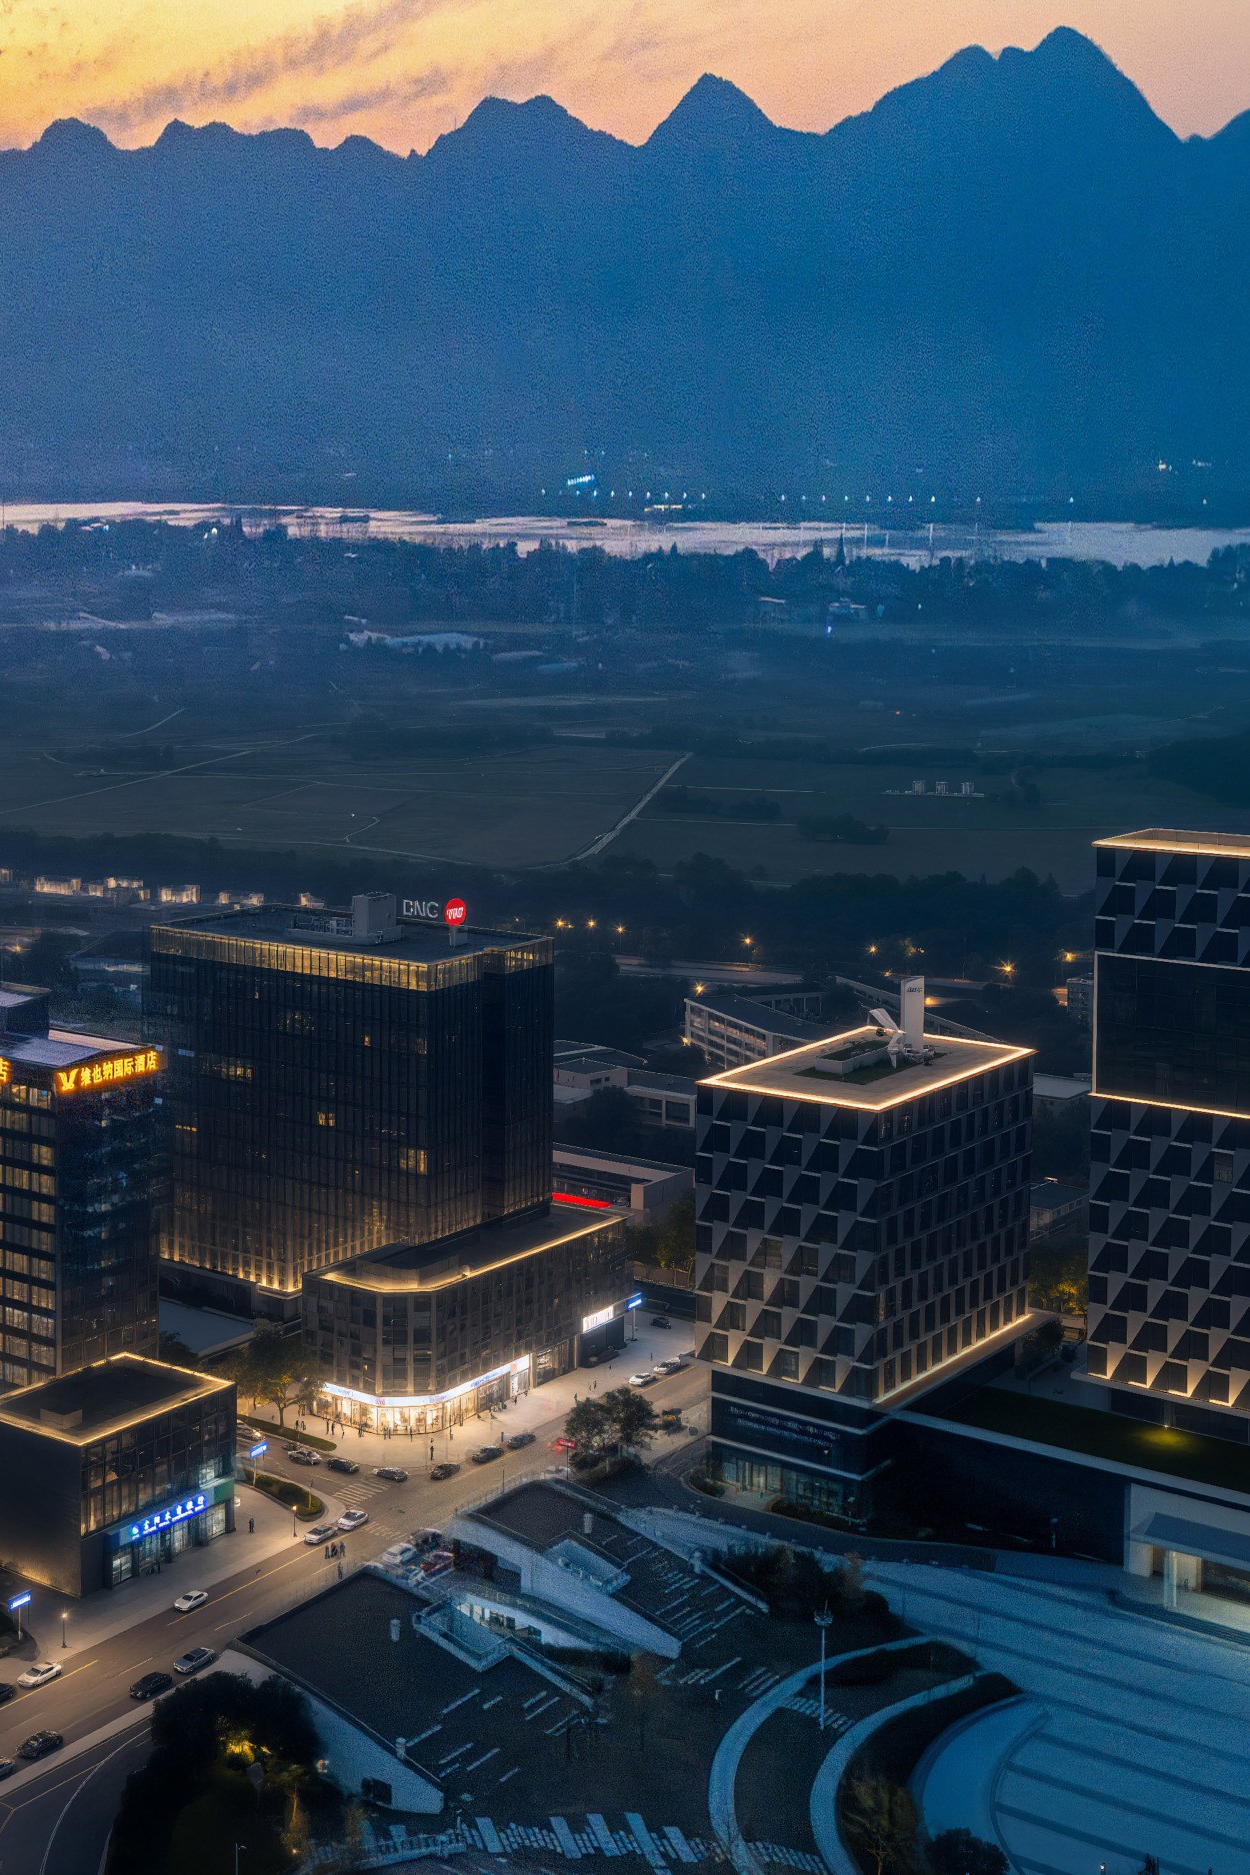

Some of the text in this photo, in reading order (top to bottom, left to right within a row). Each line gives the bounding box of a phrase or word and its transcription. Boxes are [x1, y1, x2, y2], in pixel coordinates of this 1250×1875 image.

[80, 1052, 158, 1087] 维也纳国际酒店
